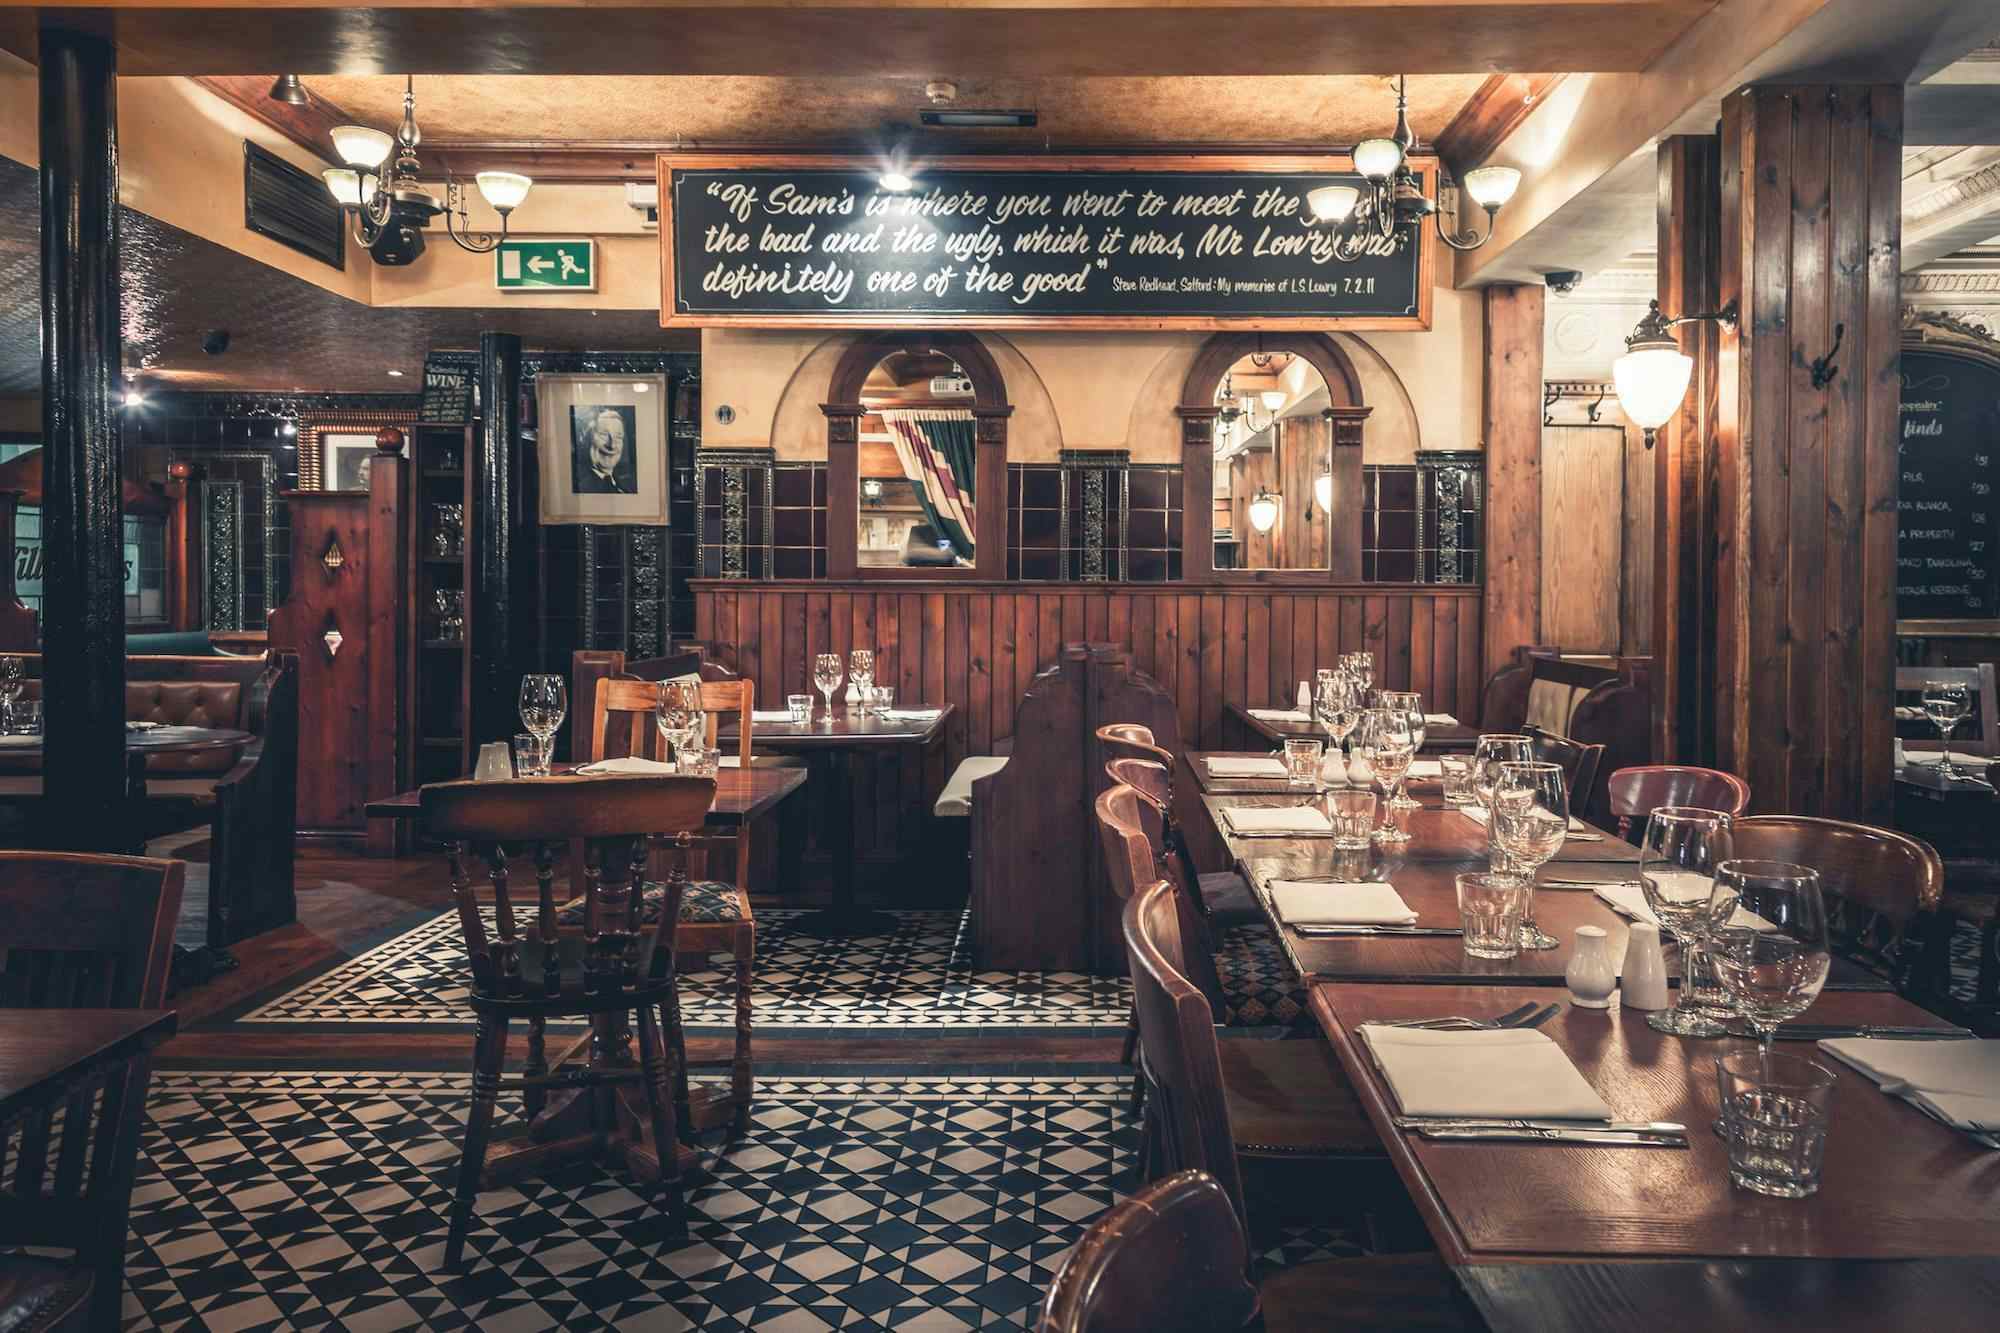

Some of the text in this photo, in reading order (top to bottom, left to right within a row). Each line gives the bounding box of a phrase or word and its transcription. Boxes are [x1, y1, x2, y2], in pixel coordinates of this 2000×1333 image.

[865, 187, 892, 216] is
[902, 186, 989, 216] where
[987, 192, 1052, 224] you
[1062, 189, 1134, 217] went
[1137, 189, 1168, 217] to
[1172, 188, 1246, 217] meet
[1252, 186, 1301, 218] the
[705, 222, 751, 253] the
[759, 222, 815, 254] bad
[822, 222, 881, 254] and
[891, 223, 937, 254] the
[944, 223, 1005, 263] ugly,
[1014, 223, 1091, 255] which
[1098, 226, 1125, 255] it
[1129, 230, 1185, 261] was,
[1196, 223, 1244, 258] Mr
[1253, 224, 1342, 265] Lowry
[702, 261, 855, 304] definitely
[866, 269, 918, 294] one
[923, 265, 958, 298] of
[965, 262, 1014, 293] the
[1112, 275, 1137, 292] Steve
[1235, 278, 1276, 293] memories
[1278, 278, 1289, 293] of
